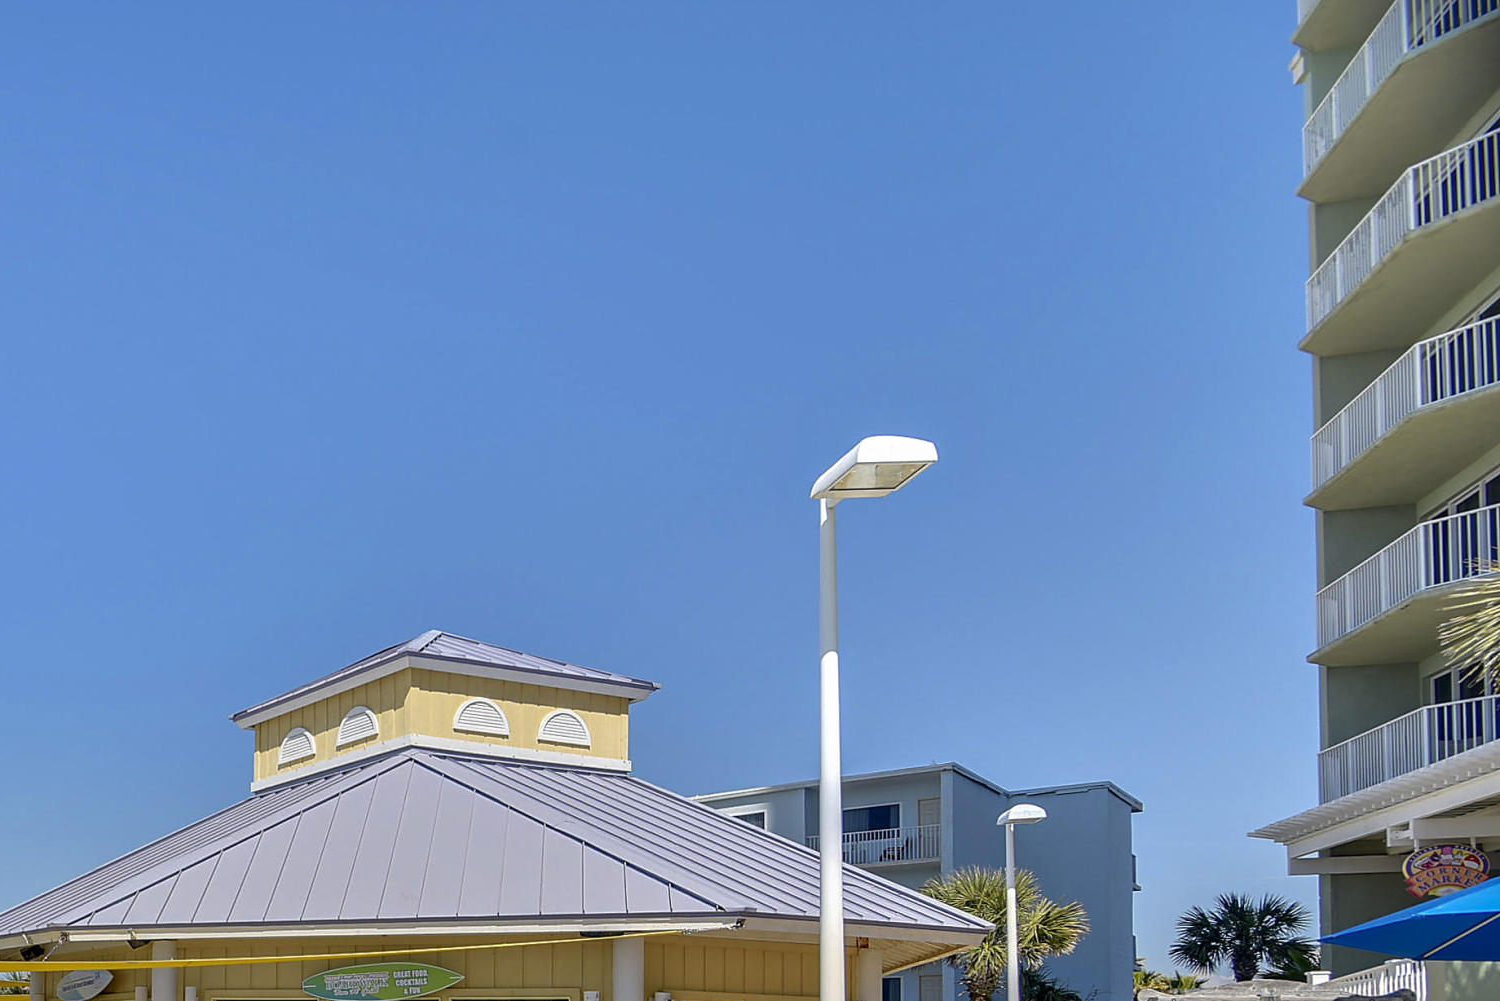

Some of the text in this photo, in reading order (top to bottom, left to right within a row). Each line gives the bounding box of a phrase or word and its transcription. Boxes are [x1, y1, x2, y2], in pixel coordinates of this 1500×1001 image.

[1415, 867, 1483, 883] CORNER
[1417, 875, 1477, 892] MARKE
[396, 978, 428, 986] COCKTAILS
